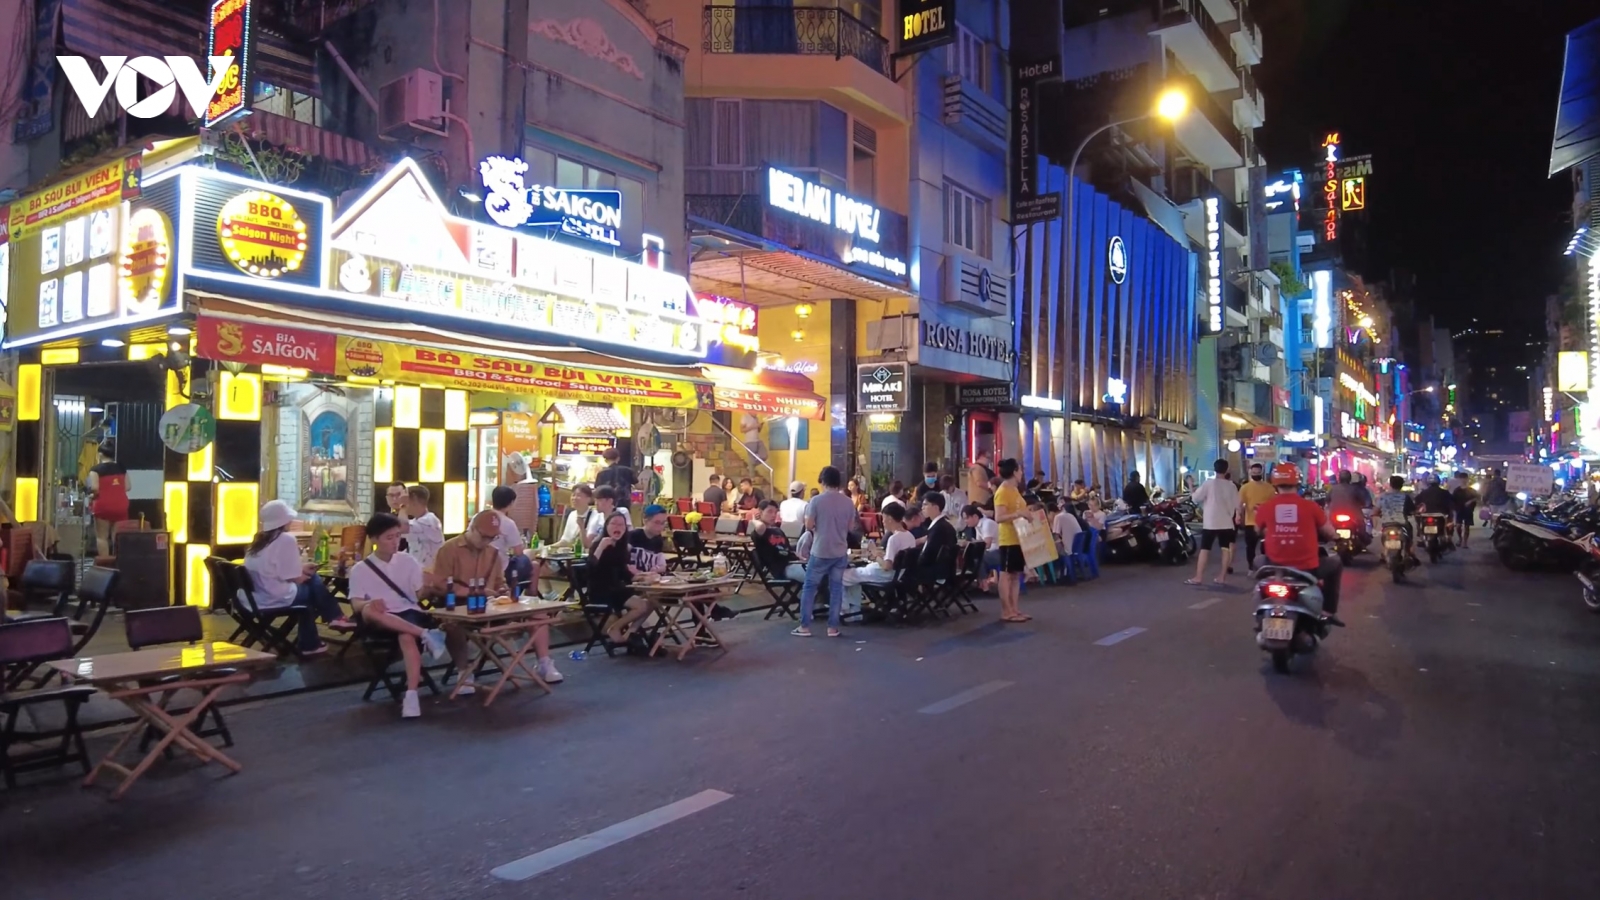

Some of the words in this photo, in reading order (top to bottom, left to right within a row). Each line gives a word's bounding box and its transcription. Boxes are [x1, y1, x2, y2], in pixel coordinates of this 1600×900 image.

[904, 6, 945, 40] HOTEL
[1019, 61, 1053, 78] Hotel
[249, 202, 282, 220] BBQ
[543, 186, 620, 229] SAIGON
[1016, 208, 1056, 219] Restaurant
[835, 193, 880, 243] HOTEL
[232, 224, 267, 240] Saigon
[269, 231, 295, 245] Night
[252, 339, 318, 361] SAIGON
[356, 341, 372, 349] BBQ
[924, 320, 967, 353] ROSA
[968, 331, 1010, 363] HOTEL
[453, 368, 487, 380] BBQ
[490, 373, 502, 381] &
[569, 382, 613, 393] Saigon
[616, 387, 648, 396] Night
[660, 381, 675, 391] 2
[870, 394, 894, 402] HOTEL
[962, 388, 981, 396] ROSA
[983, 387, 1007, 396] HOTEL
[776, 396, 819, 407] NHUNG
[1275, 525, 1298, 533] Now
